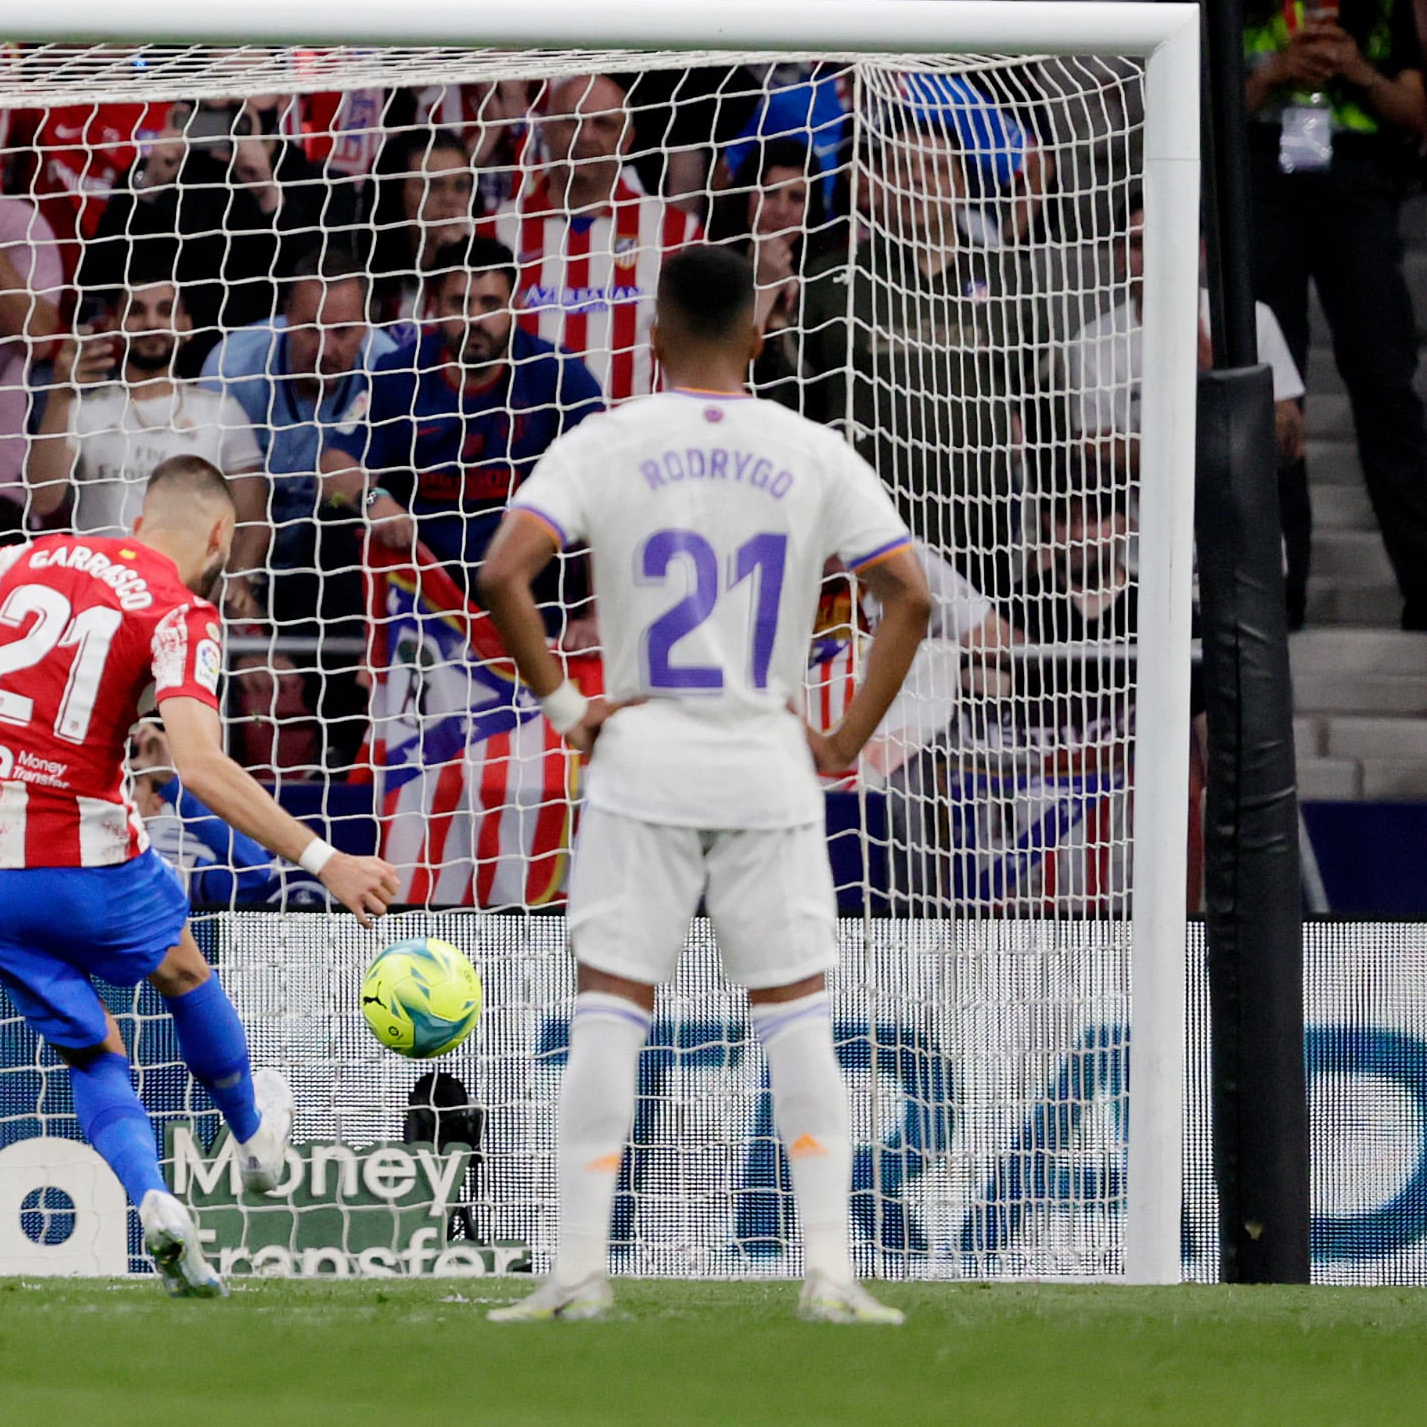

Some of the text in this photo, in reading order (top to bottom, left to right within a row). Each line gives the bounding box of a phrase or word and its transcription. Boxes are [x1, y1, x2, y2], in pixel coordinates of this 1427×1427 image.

[638, 447, 795, 501] RODRYGO
[29, 544, 154, 612] CARRASCO
[633, 526, 789, 694] 21
[12, 767, 71, 790] Transfer
[17, 750, 68, 778] Money
[166, 1121, 465, 1217] Money
